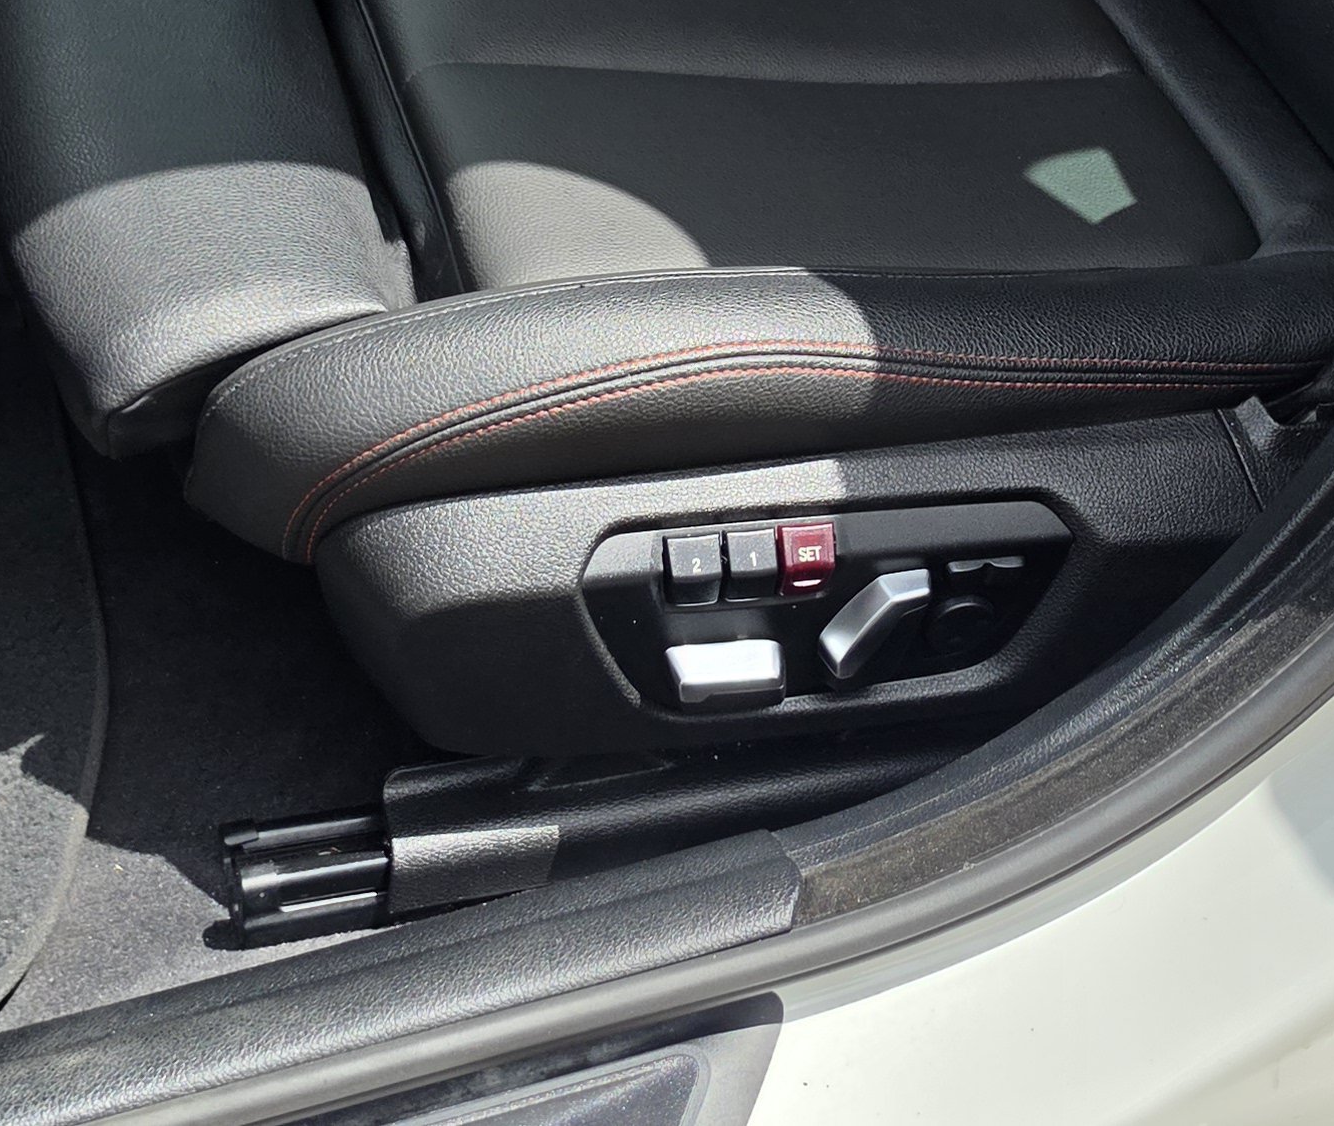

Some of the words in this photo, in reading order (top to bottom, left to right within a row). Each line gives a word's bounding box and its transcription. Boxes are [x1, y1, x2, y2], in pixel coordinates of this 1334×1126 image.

[750, 552, 757, 566] 1
[798, 546, 822, 562] SET
[692, 558, 701, 573] 2
